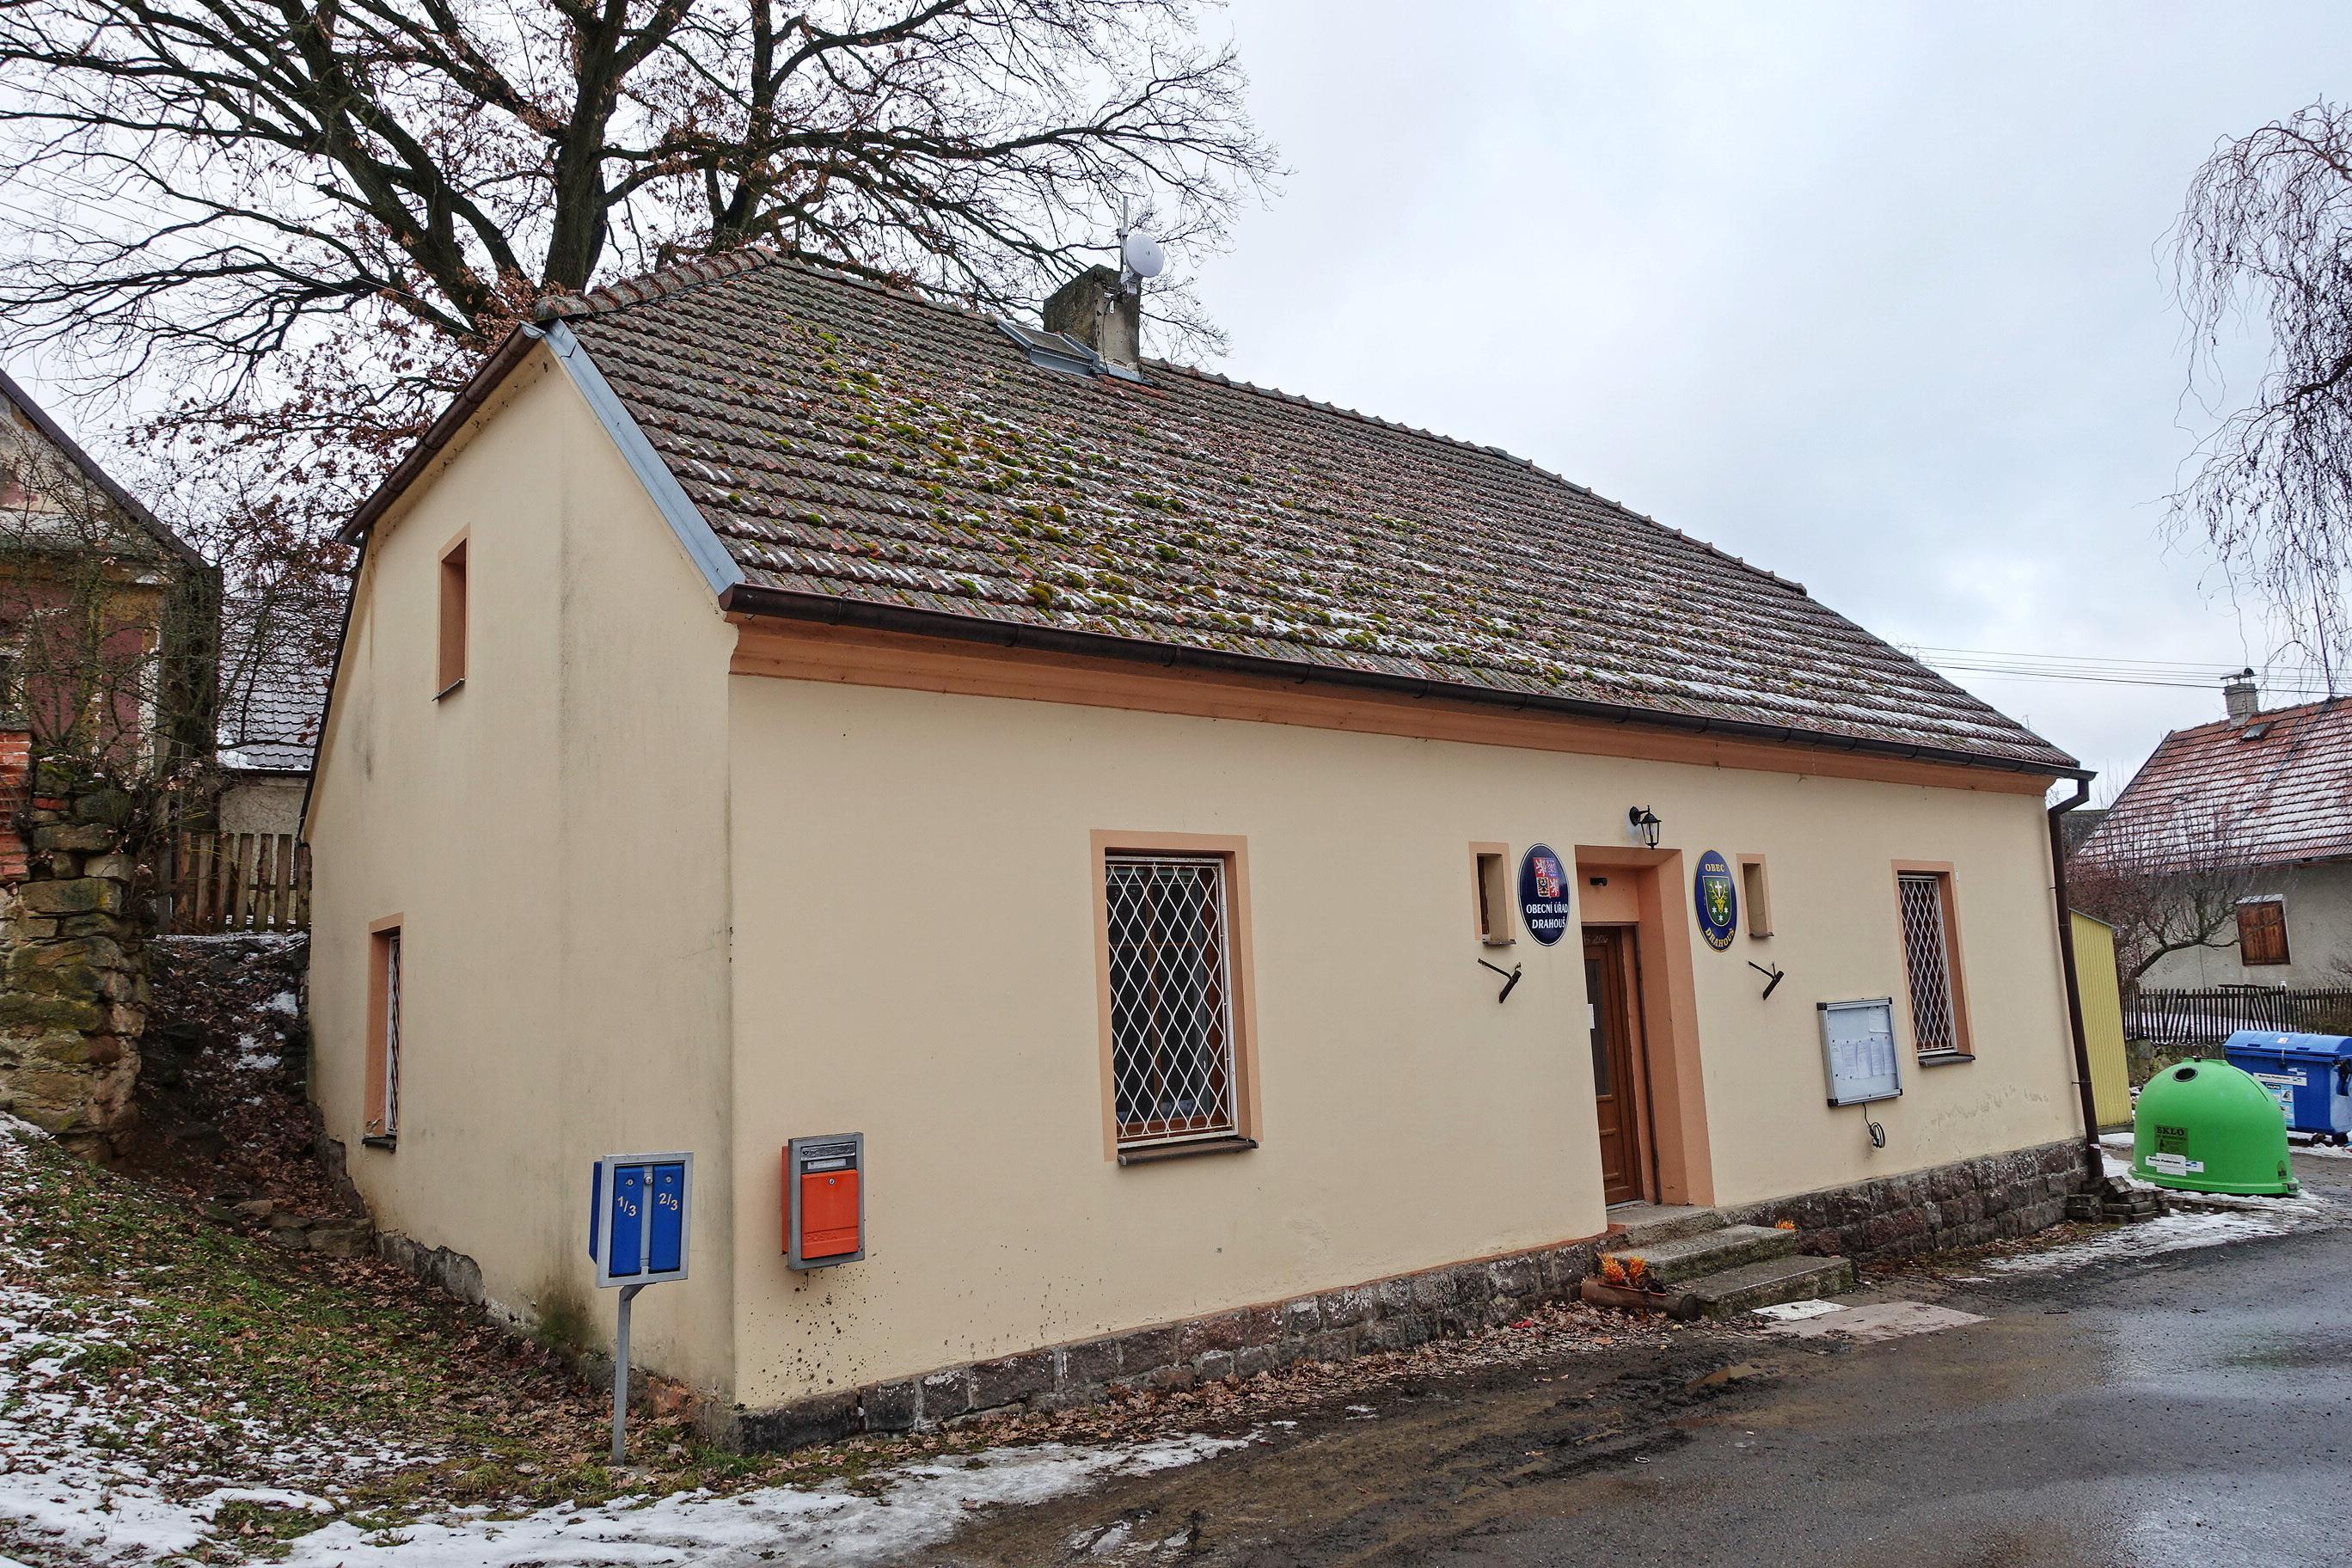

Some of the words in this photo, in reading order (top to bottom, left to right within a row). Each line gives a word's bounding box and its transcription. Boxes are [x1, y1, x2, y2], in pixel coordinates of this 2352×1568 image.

[1706, 863, 1724, 872] OBEC
[1526, 902, 1553, 914] OBECNÍ
[1554, 901, 1569, 914] ÚŘAD
[1532, 916, 1565, 929] DRAHOUŠ
[2157, 1126, 2184, 1136] SKLO
[618, 1196, 636, 1216] 1/3
[659, 1193, 678, 1210] 2/3
